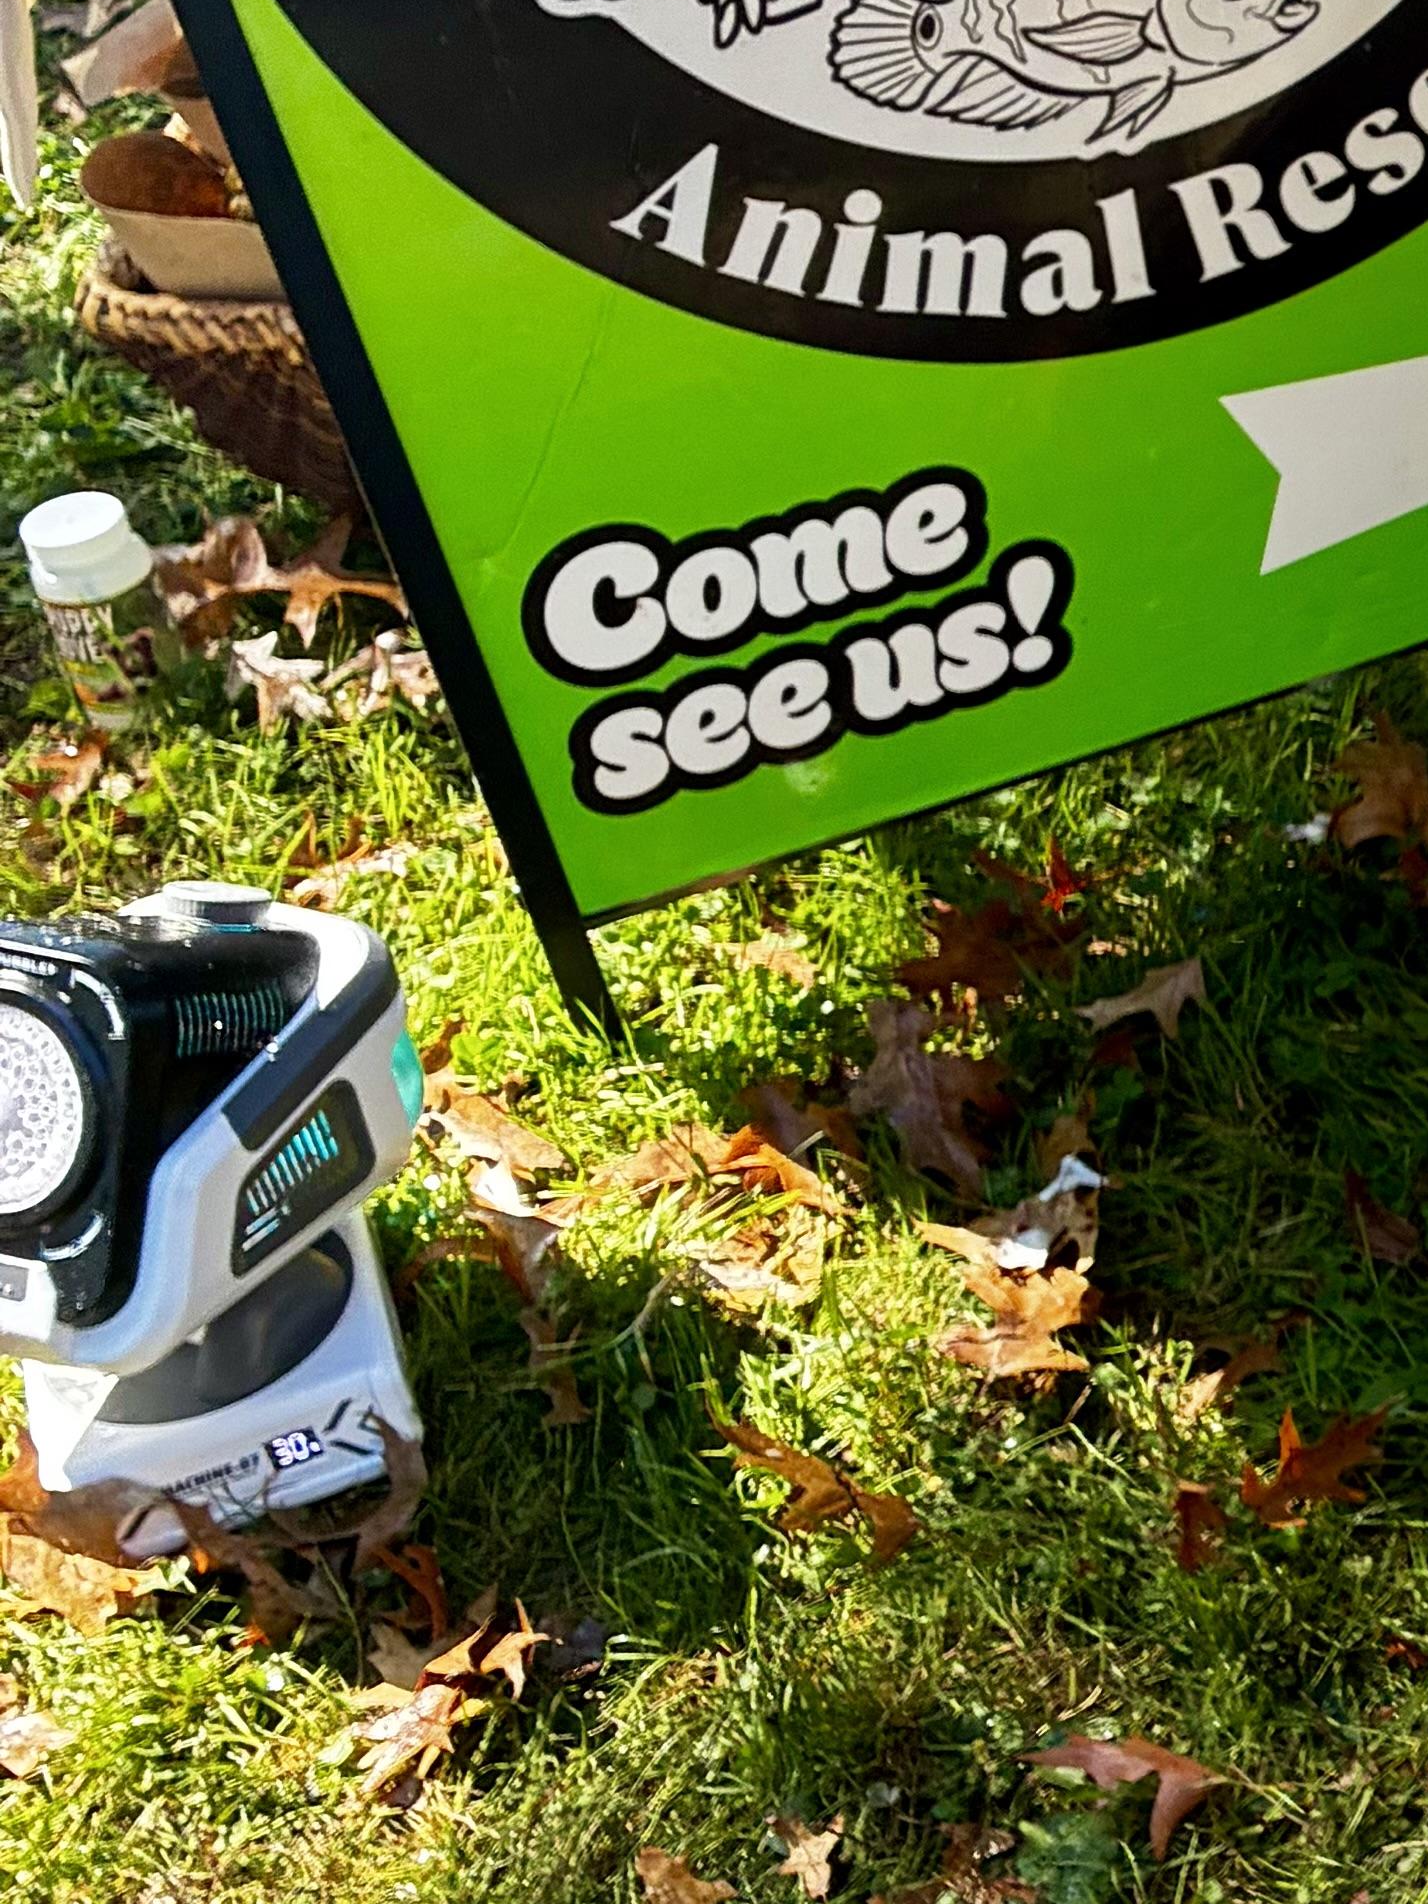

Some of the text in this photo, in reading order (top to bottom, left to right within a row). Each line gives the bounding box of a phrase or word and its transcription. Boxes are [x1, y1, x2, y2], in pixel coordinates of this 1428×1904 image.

[610, 143, 1158, 318] Animal
[543, 482, 969, 672] Come
[590, 555, 1056, 800] see us!
